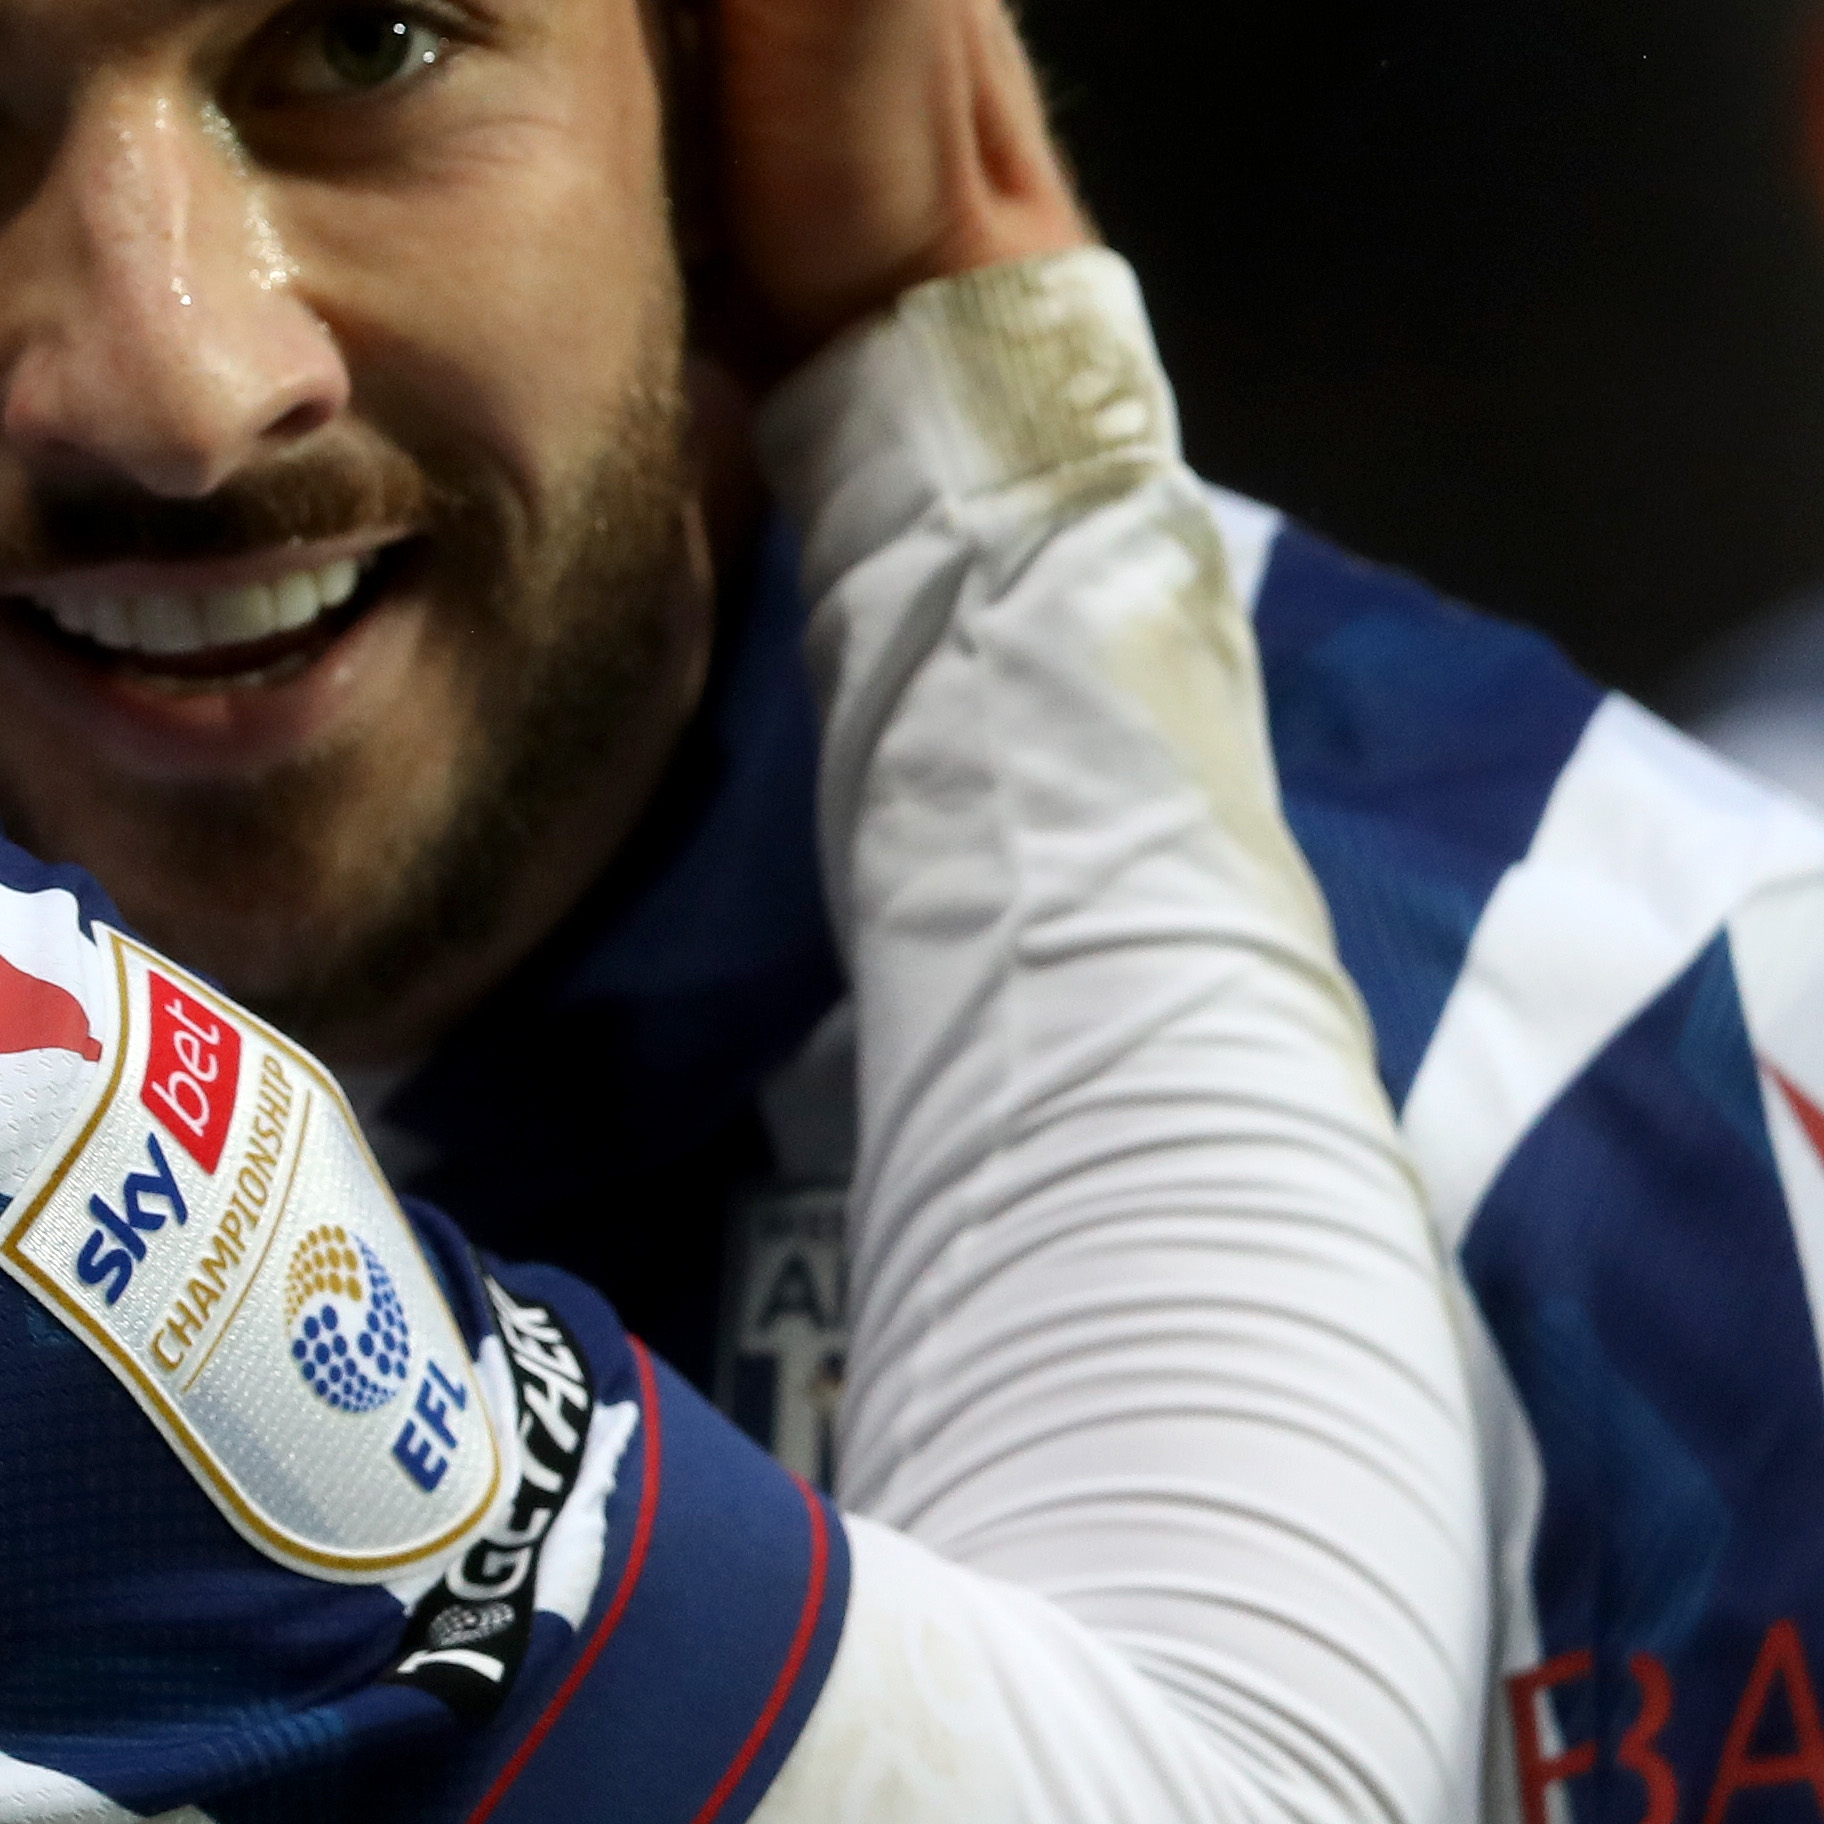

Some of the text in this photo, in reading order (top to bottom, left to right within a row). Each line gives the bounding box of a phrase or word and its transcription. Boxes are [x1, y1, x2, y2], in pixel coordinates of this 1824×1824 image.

[76, 996, 224, 1306] sky bet
[151, 1052, 288, 1373] CHAMPIONSHIP
[391, 1359, 468, 1494] EFL
